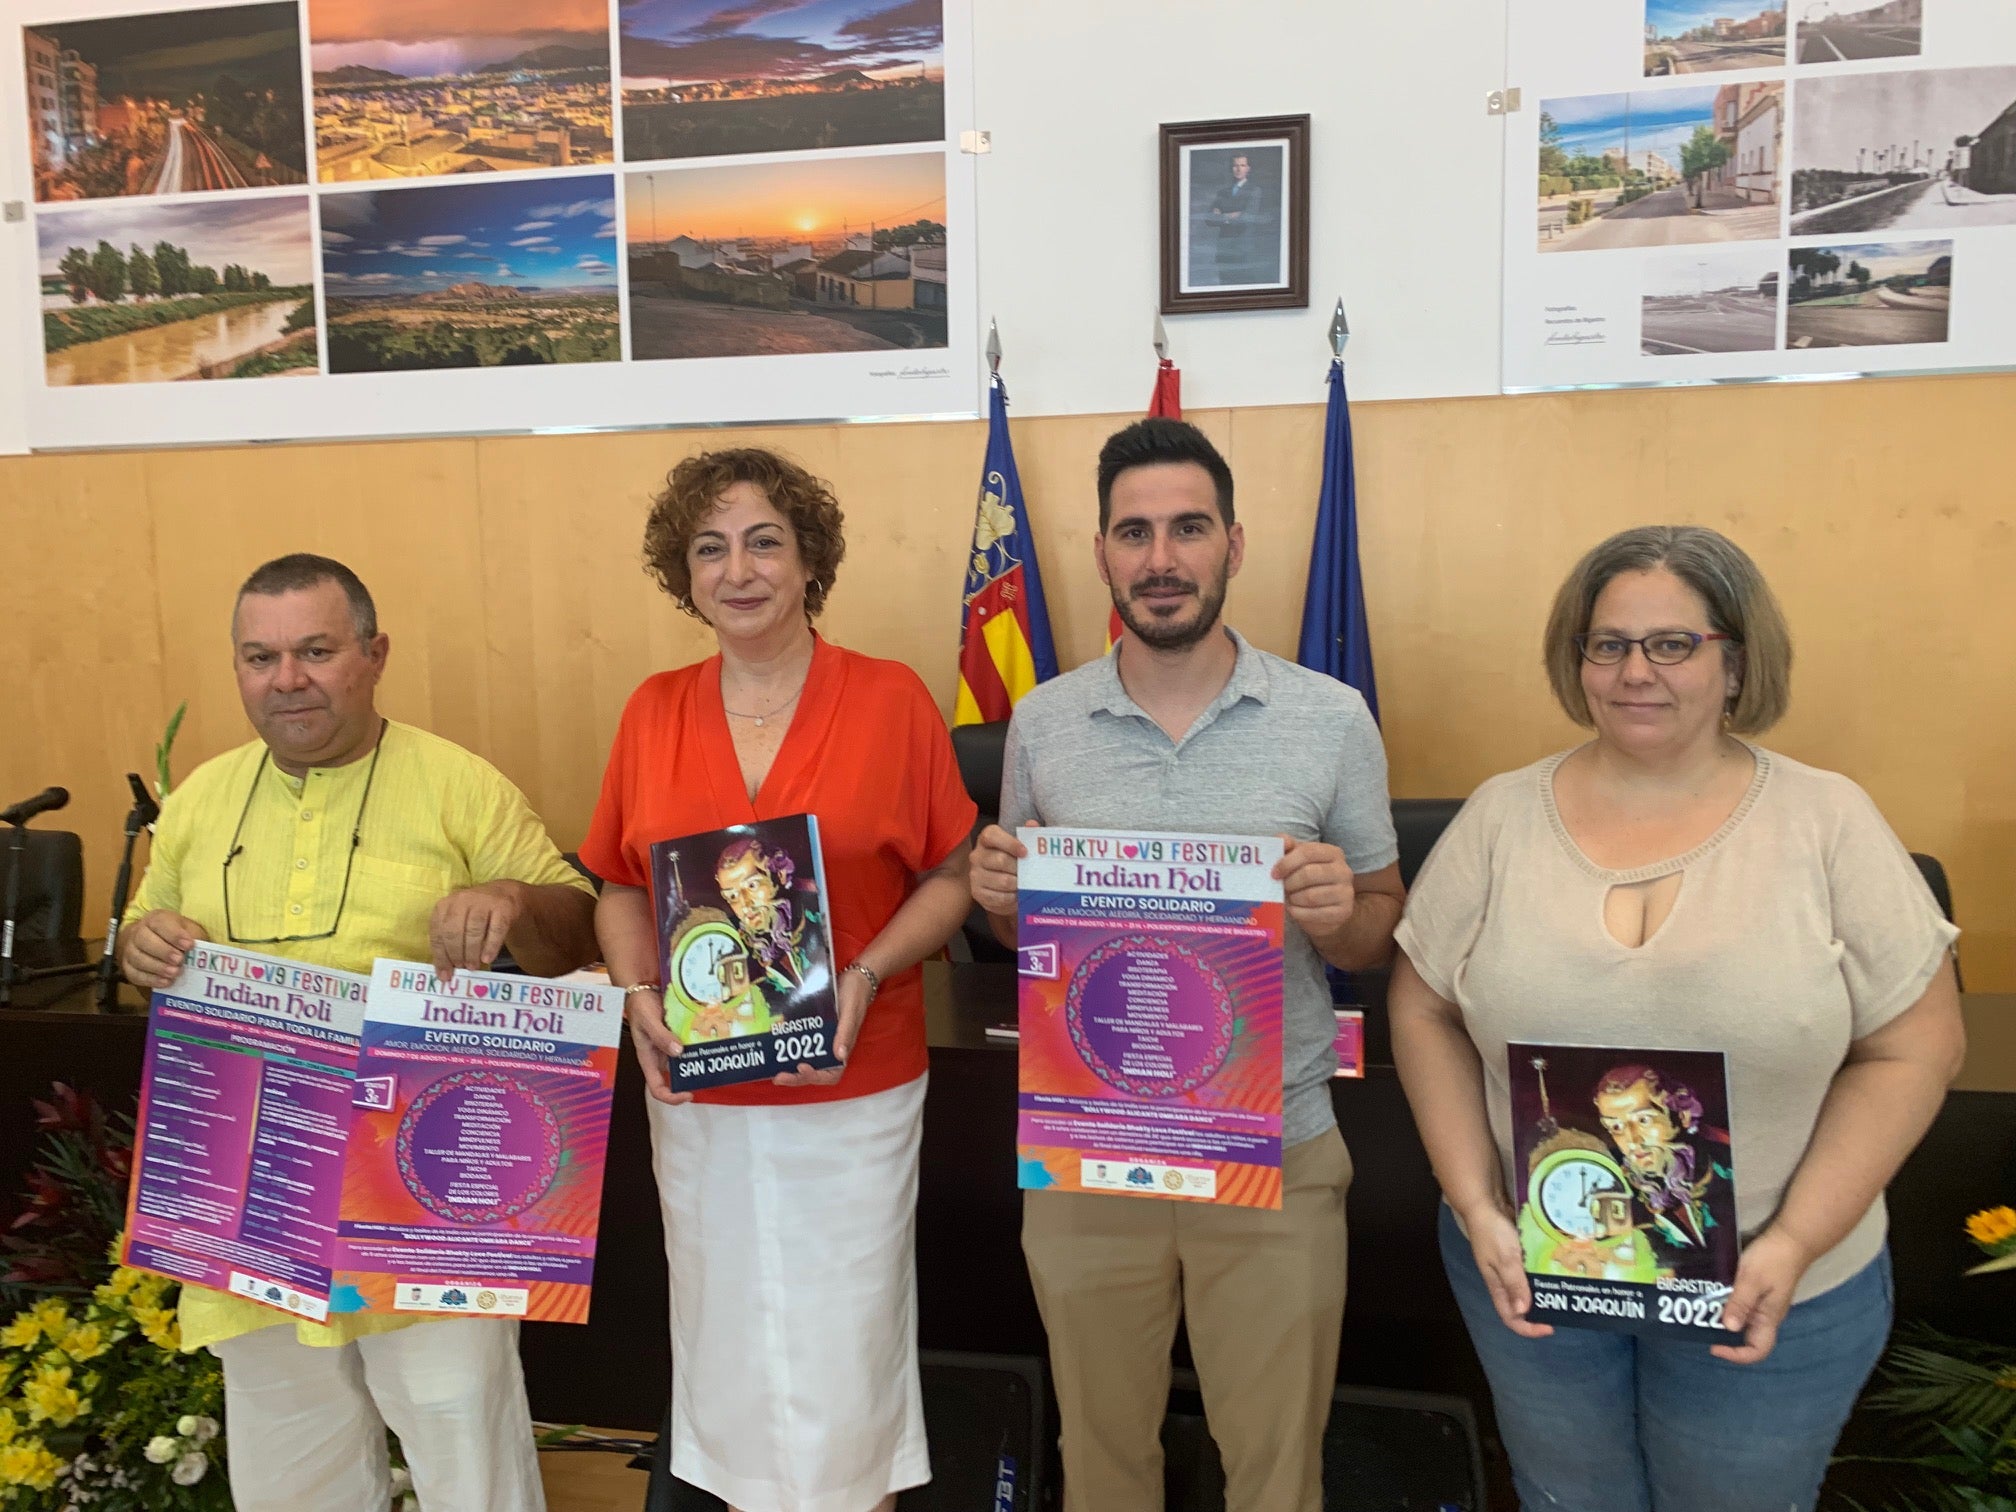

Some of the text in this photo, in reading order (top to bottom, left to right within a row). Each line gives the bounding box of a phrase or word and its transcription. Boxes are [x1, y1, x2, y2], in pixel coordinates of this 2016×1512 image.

[1074, 863, 1222, 895] Indian Holi
[1080, 895, 1215, 913] EVENTO SOLIDARIO
[1143, 911, 1196, 922] SOLIDARIDAD
[1198, 914, 1203, 922] Y
[1205, 914, 1258, 925] HERMANDAD
[203, 976, 280, 1011] Indian
[285, 993, 332, 1022] Holi
[166, 998, 204, 1014] EVENTO
[204, 1006, 257, 1024] SOLIDARIO
[257, 1016, 284, 1031] PARA
[286, 1022, 313, 1036] TODA
[314, 1028, 326, 1040] LA
[420, 997, 566, 1037] Indian Holi
[771, 1015, 823, 1036] BIGASTRO
[231, 1034, 296, 1054] PROGRAMACIÓN
[424, 1029, 556, 1054] EVENTO SOLIDARIO
[699, 1046, 729, 1056] Patronales
[738, 1042, 755, 1050] honor
[774, 1032, 827, 1063] 2022
[484, 1048, 537, 1060] SOLIDARIDAD
[544, 1054, 594, 1067] HERMANDAD
[679, 1048, 766, 1078] SAN JOAQUÍN
[1533, 1278, 1560, 1290] Fiestas
[1560, 1281, 1601, 1293] Patronales
[1611, 1286, 1634, 1296] honor
[1656, 1276, 1727, 1294] BIGASTRO
[1534, 1291, 1645, 1319] SAN JOAQUÍN
[1658, 1295, 1726, 1329] 2022
